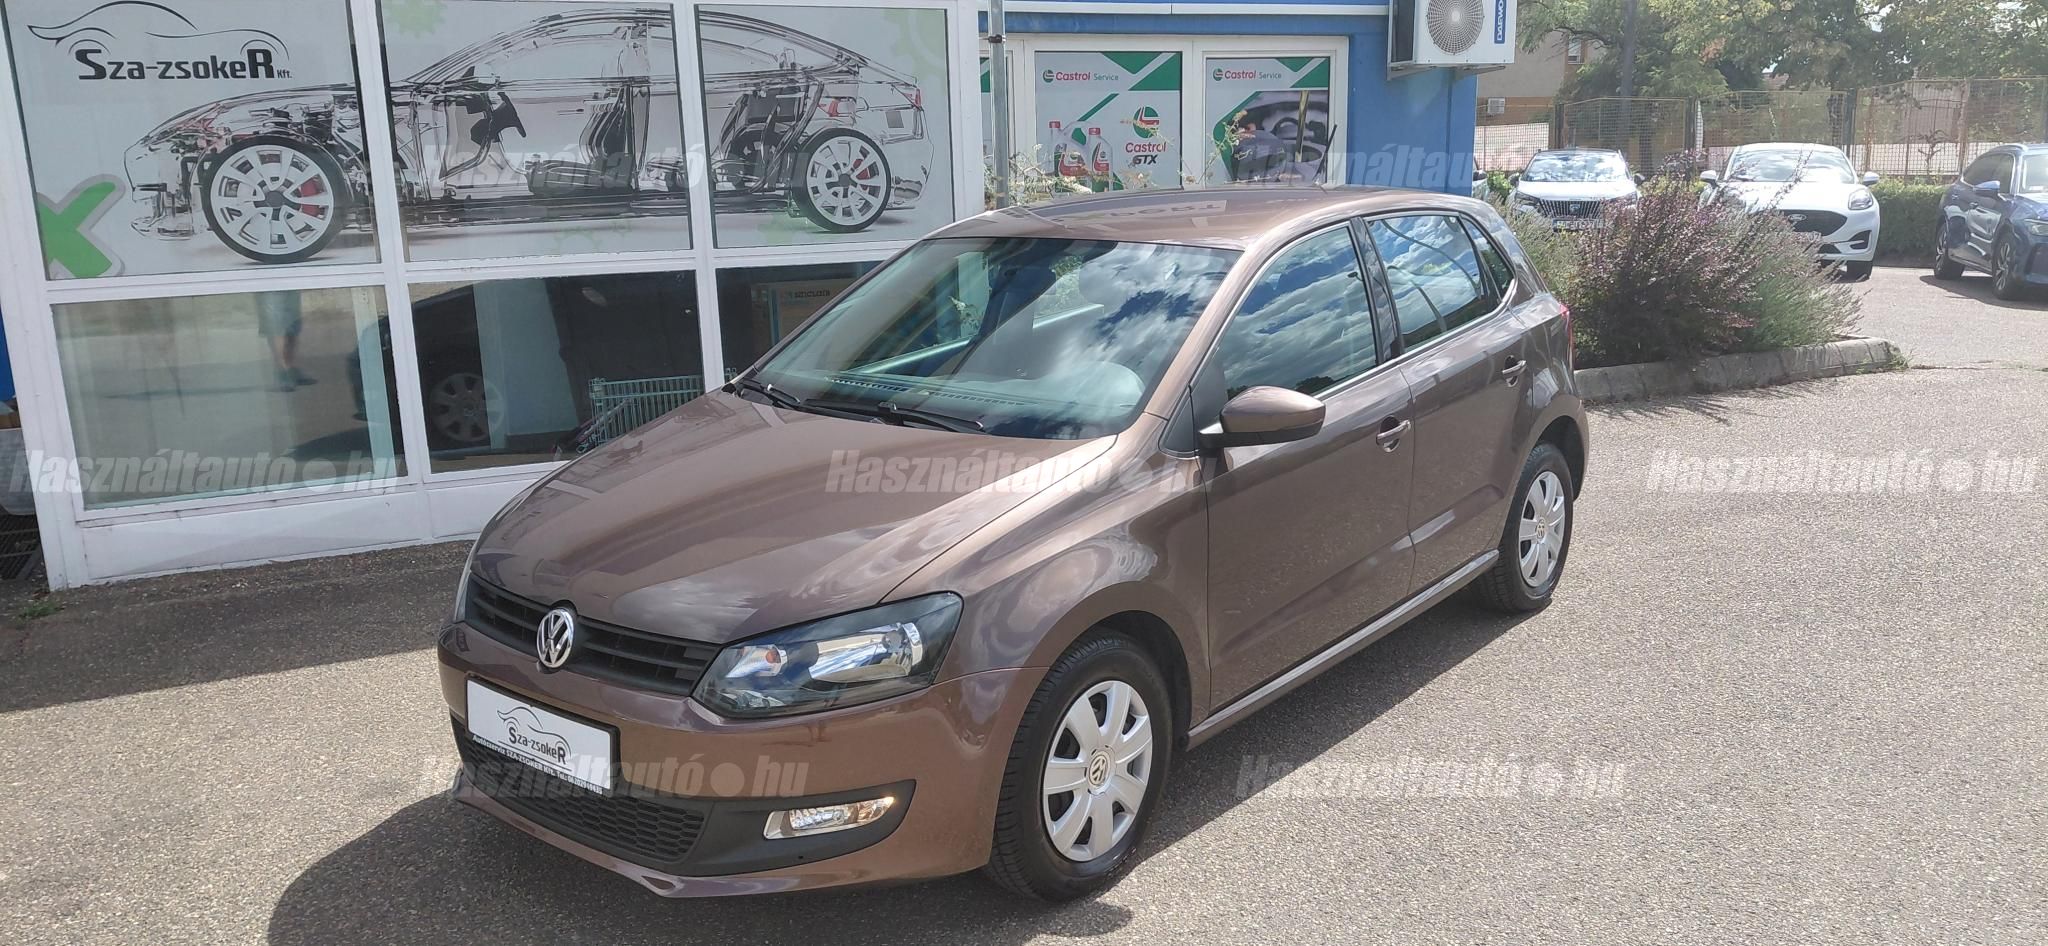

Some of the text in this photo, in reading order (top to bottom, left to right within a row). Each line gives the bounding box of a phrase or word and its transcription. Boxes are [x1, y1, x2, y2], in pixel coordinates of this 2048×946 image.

[75, 49, 293, 80] Sza-zsokeR Kft.
[1055, 71, 1119, 81] Castrol Service
[1224, 70, 1257, 79] Castrol
[1125, 141, 1167, 153] Castrol
[1132, 154, 1158, 165] GTX
[508, 726, 567, 765] Sza-zsokeR
